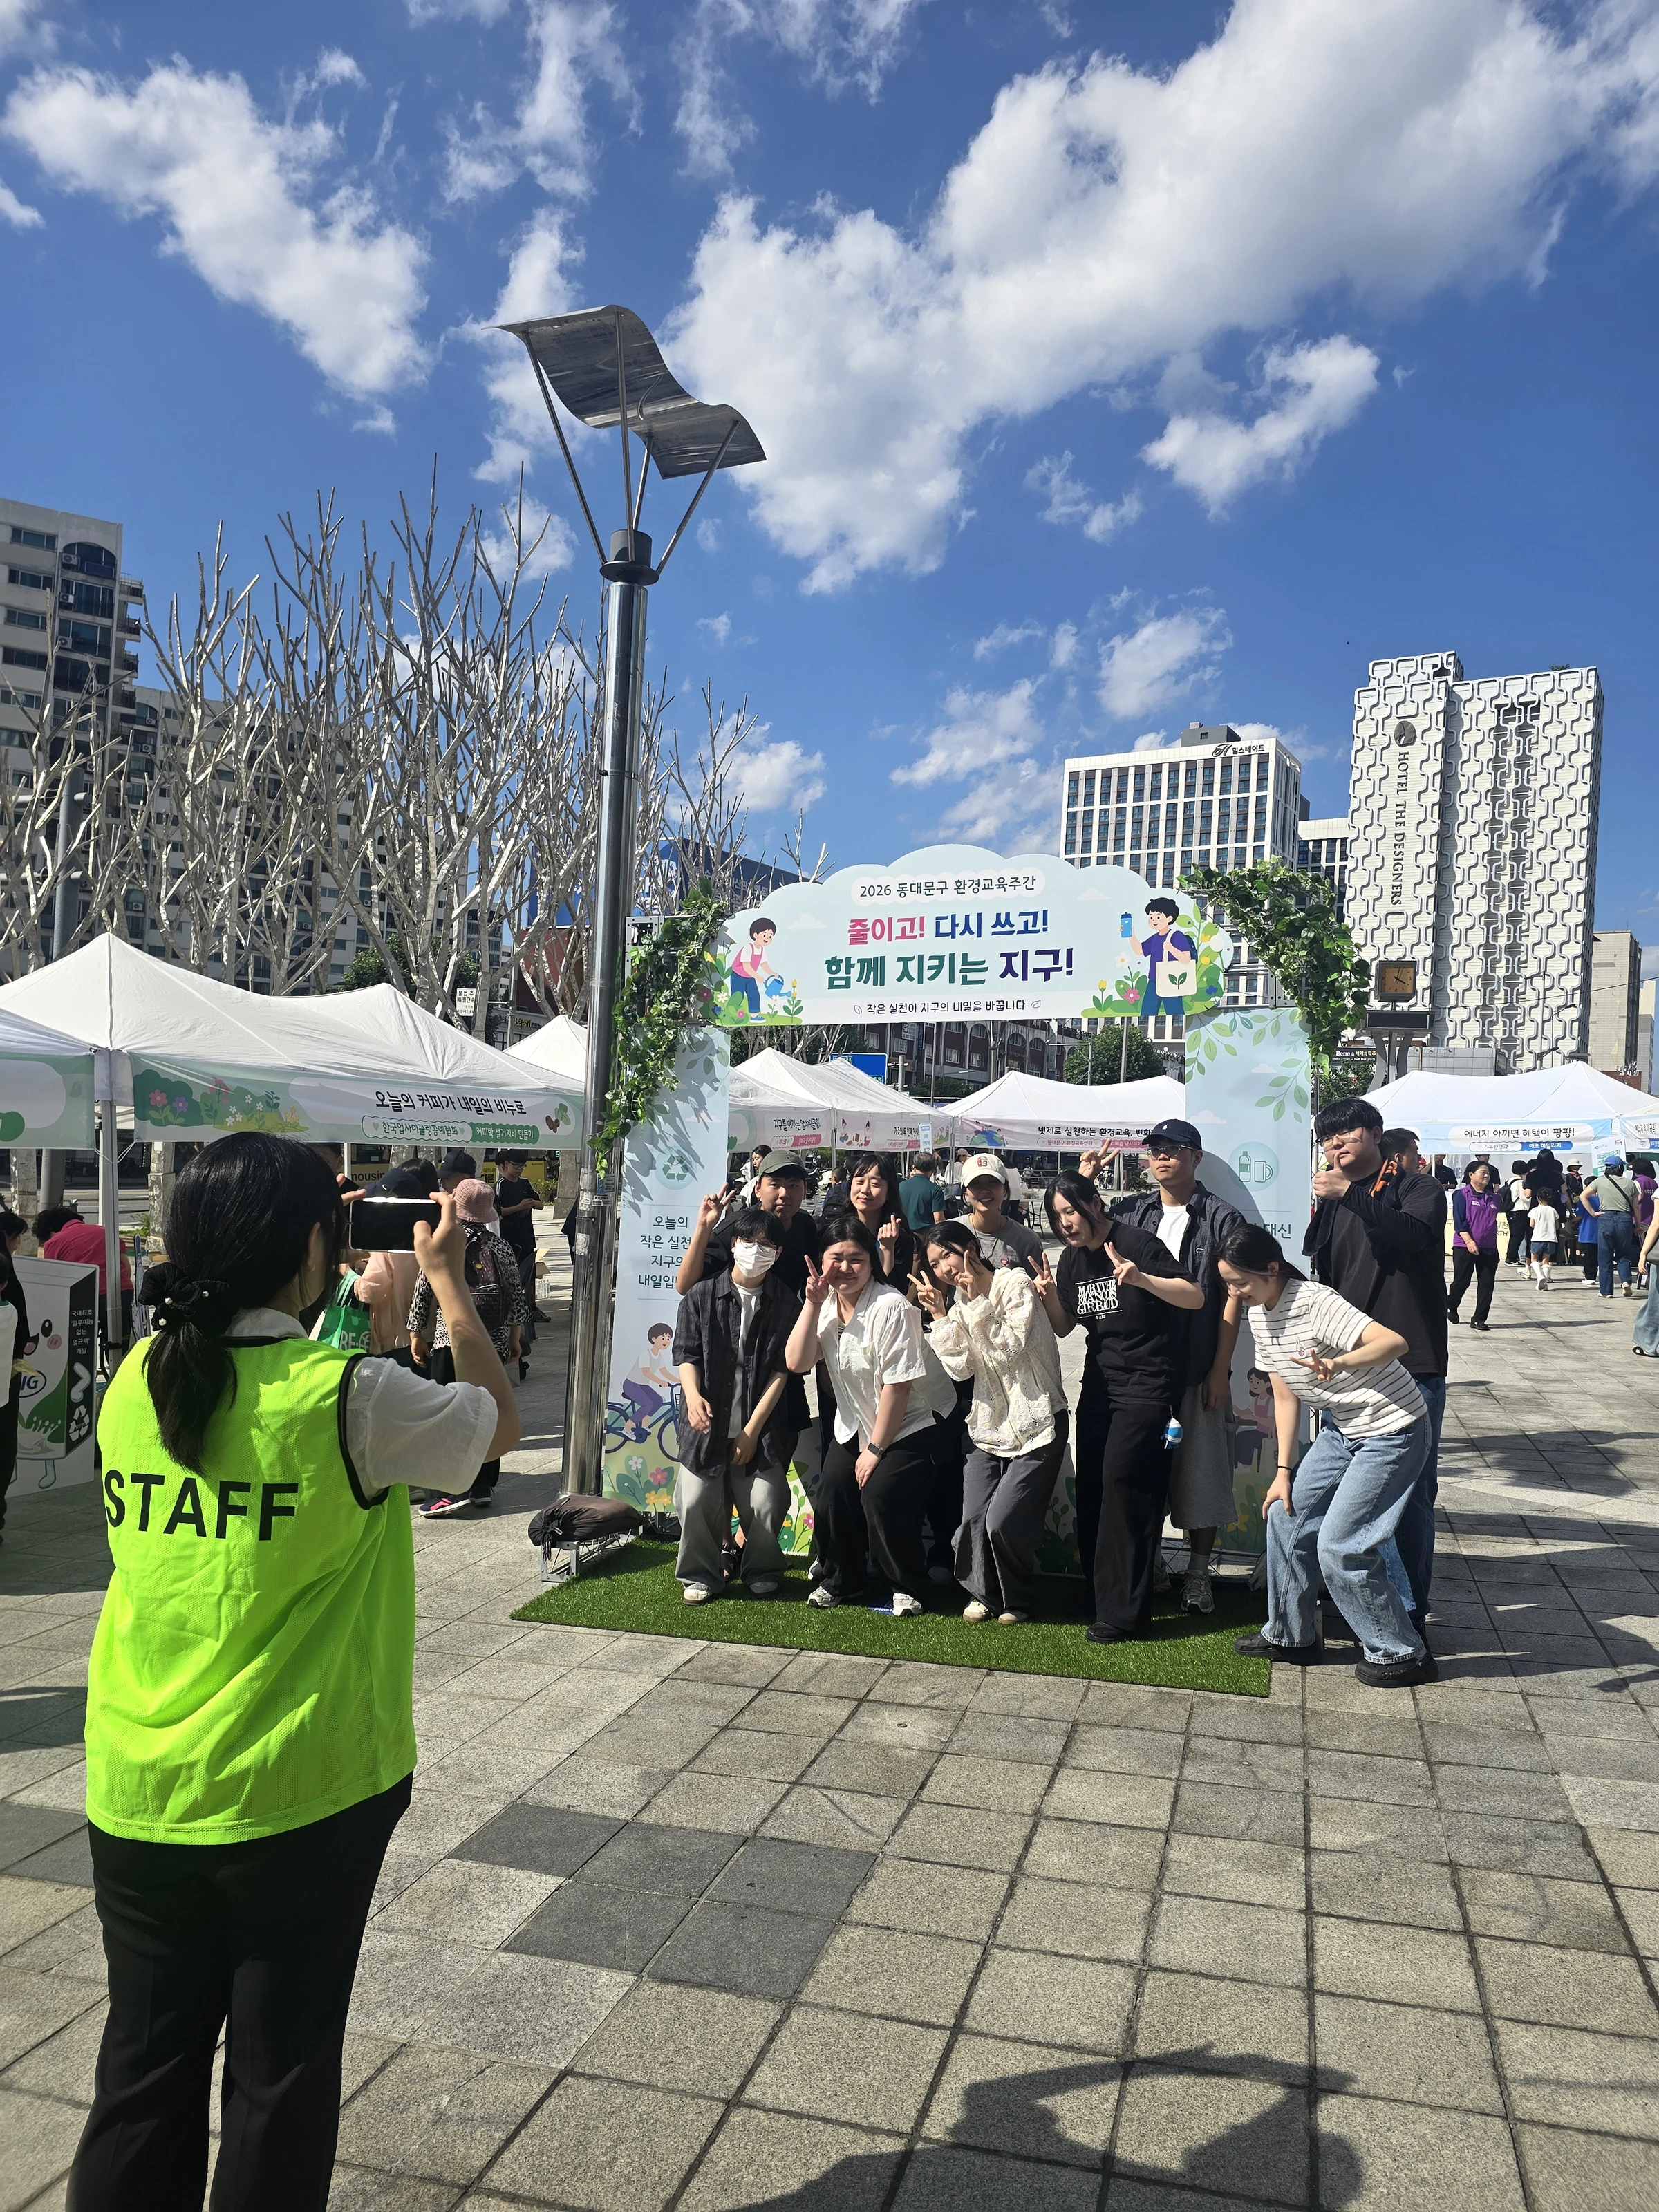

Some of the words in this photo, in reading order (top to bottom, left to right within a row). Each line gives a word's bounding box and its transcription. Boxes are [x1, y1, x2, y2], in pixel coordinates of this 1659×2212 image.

[1232, 744, 1264, 755] 힐스테이트
[1397, 751, 1409, 796] HOTEL
[1395, 800, 1407, 828] THE
[1391, 832, 1405, 906] DESIGNERS
[860, 885, 892, 897] 2026
[897, 881, 949, 898] 동대문구
[953, 876, 1036, 895] 환경교육주간
[847, 916, 925, 945] 줄이고!
[935, 912, 982, 939] 다시
[991, 909, 1049, 936] 쓰고!
[824, 955, 886, 989] 함께
[896, 953, 989, 985] 지키는
[999, 948, 1074, 982] 지구!
[867, 1003, 885, 1015] 작은
[888, 1002, 917, 1014] 실천이
[920, 1002, 949, 1013] 지구의
[953, 1000, 982, 1012] 내일을
[986, 1000, 1026, 1011] 바꿉니다
[375, 1091, 416, 1112] 오늘의
[416, 1094, 455, 1110] 커피가
[457, 1096, 494, 1116] 내일의
[494, 1098, 527, 1116] 비누로
[382, 1121, 458, 1137] 한국업사이클링공예협회
[476, 1127, 494, 1138] 커피박
[495, 1128, 517, 1139] 설거지바
[518, 1129, 534, 1141] 만들기
[1038, 1127, 1062, 1135] 넷제로
[1065, 1127, 1096, 1136] 실천하는
[1099, 1128, 1132, 1137] 환경교육,
[1464, 1129, 1489, 1138] 에너지
[1493, 1129, 1519, 1138] 아끼면
[1523, 1128, 1550, 1138] 혜택이
[1553, 1127, 1575, 1138] 팡팡!
[351, 1171, 386, 1182] mousin
[653, 1216, 688, 1230] 오늘의
[640, 1235, 664, 1249] 작은
[668, 1236, 691, 1250] 실천
[639, 1275, 677, 1289] 내일입
[21, 1376, 39, 1390] IG
[104, 1470, 299, 1541] STAFF
